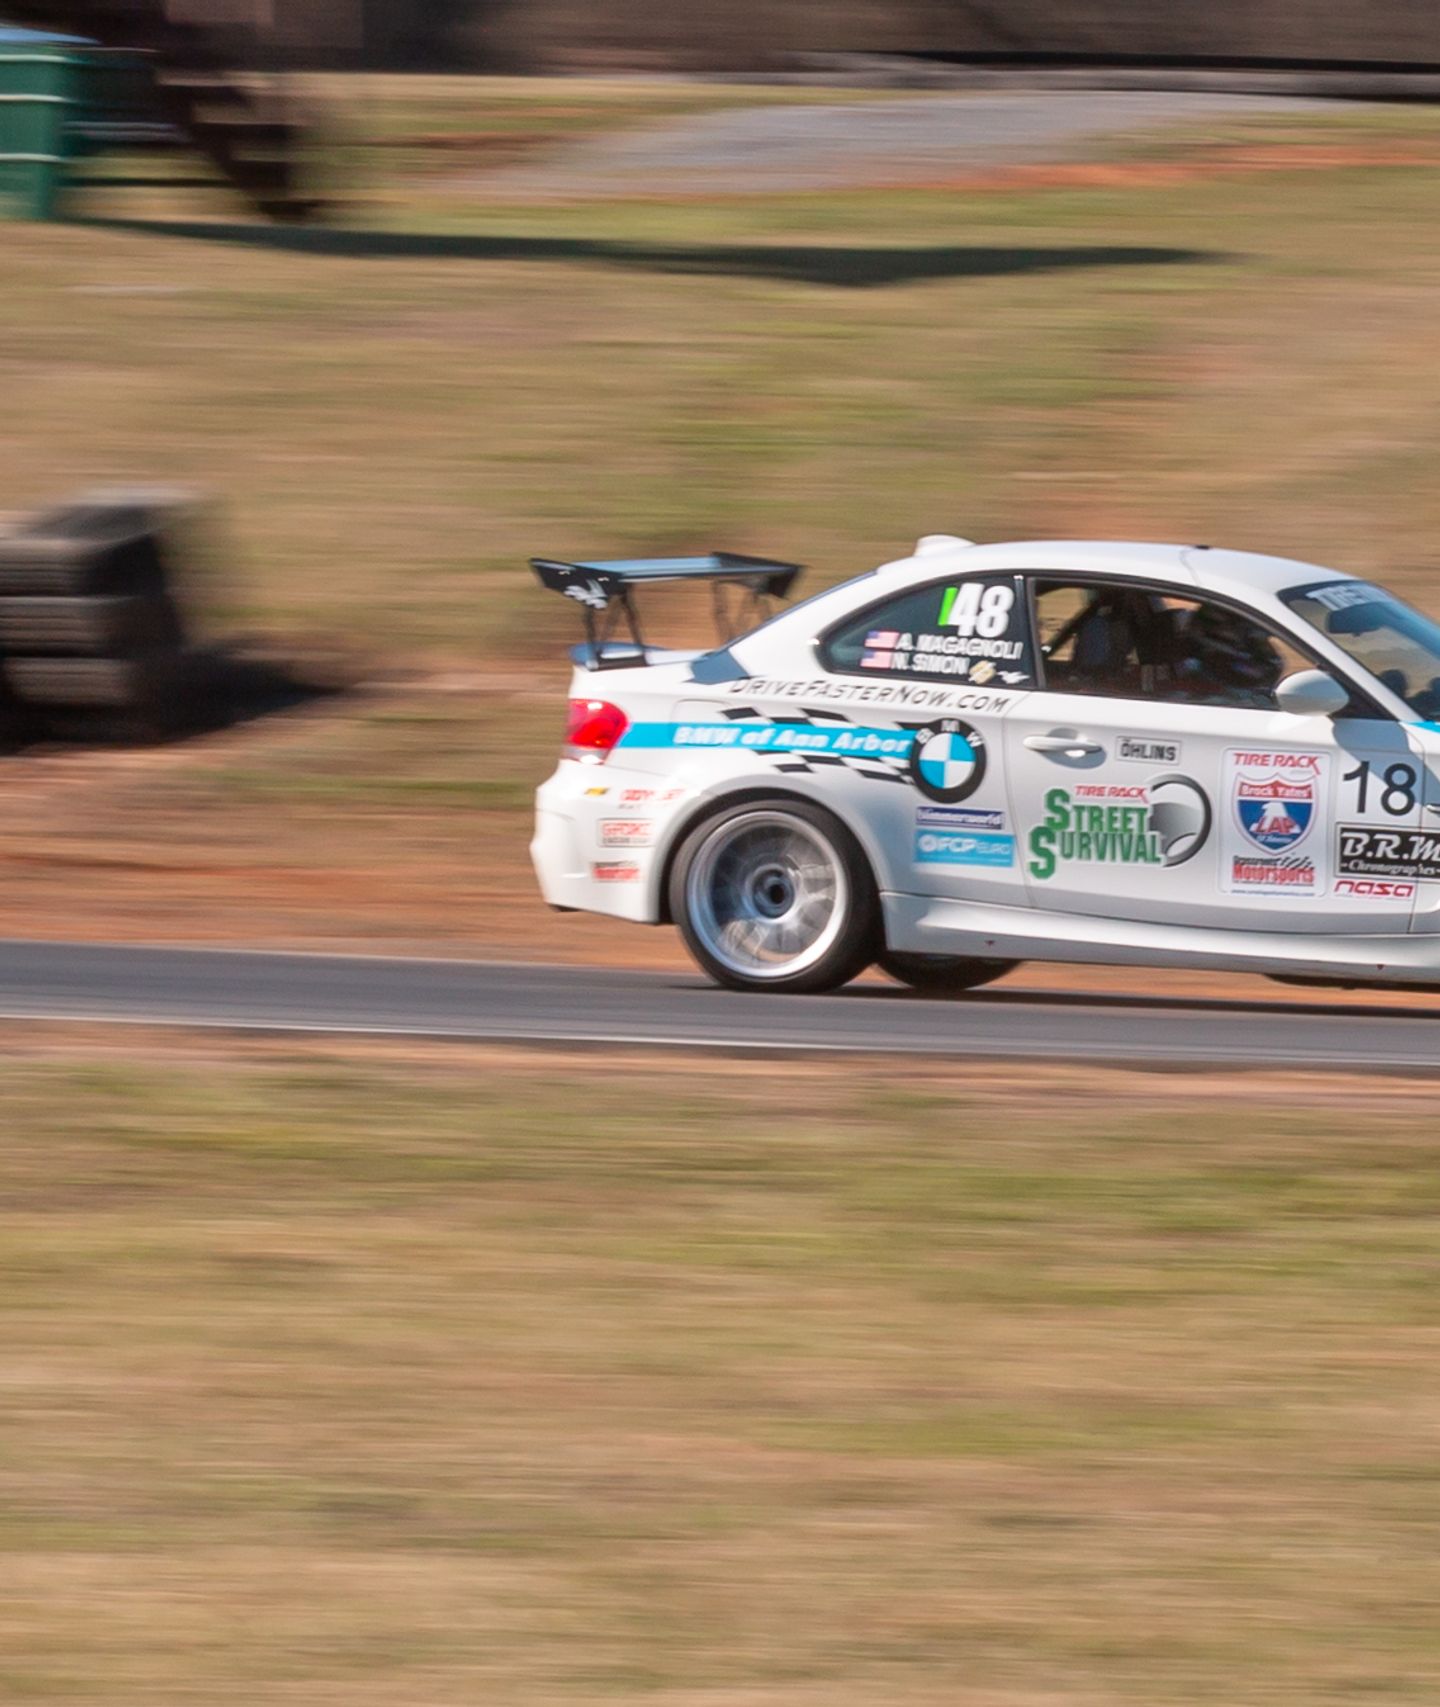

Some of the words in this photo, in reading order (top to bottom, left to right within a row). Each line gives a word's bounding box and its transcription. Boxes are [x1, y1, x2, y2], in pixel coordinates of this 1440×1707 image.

[948, 583, 1014, 637] 48
[911, 653, 971, 675] SIMON
[672, 726, 734, 745] BMW
[741, 728, 773, 746] of
[774, 729, 830, 749] Ann
[832, 733, 911, 753] Arbor
[1233, 753, 1271, 767] TIRE
[1272, 755, 1321, 775] RACK
[1075, 785, 1106, 798] TIRE
[1107, 787, 1149, 804] RACK
[1343, 761, 1417, 816] 18
[1045, 788, 1149, 832] STREET
[1256, 816, 1296, 834] LAP
[1029, 826, 1161, 880] SURVIVAL
[1233, 864, 1314, 885] Motorsports
[1334, 880, 1414, 897] nasa
